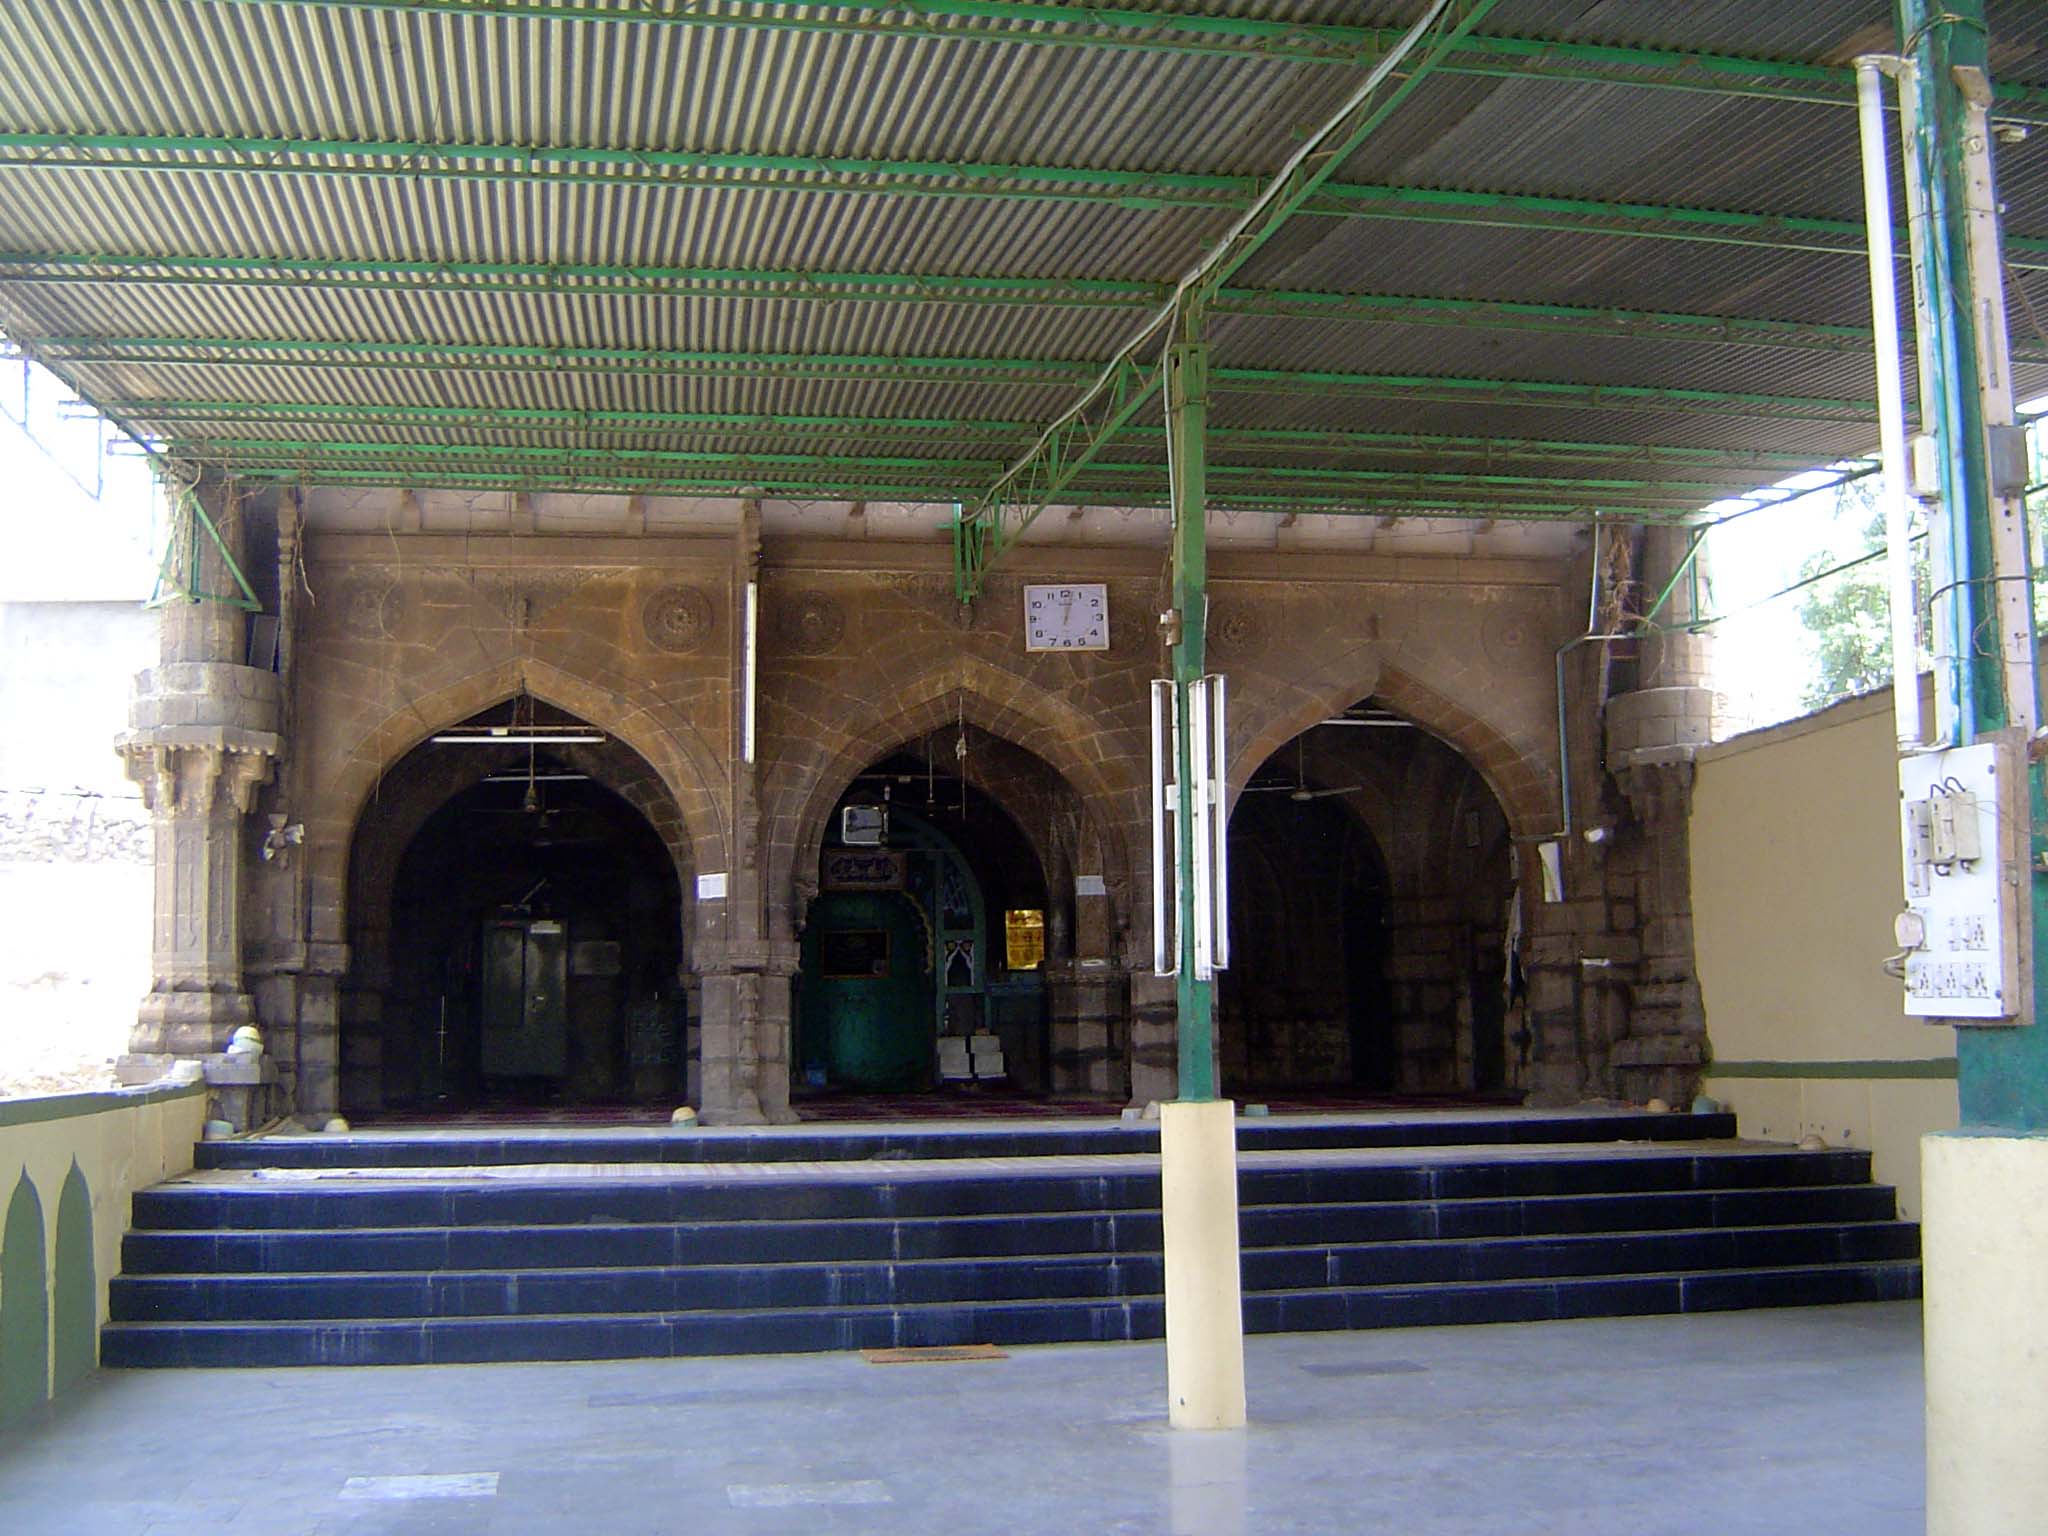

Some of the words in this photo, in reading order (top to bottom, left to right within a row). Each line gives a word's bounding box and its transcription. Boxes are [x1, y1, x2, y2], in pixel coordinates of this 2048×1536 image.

[1032, 601, 1042, 609] 10
[1091, 599, 1099, 607] 2
[1096, 613, 1104, 622] 3
[1090, 629, 1098, 637] 4
[1049, 638, 1057, 646] 7
